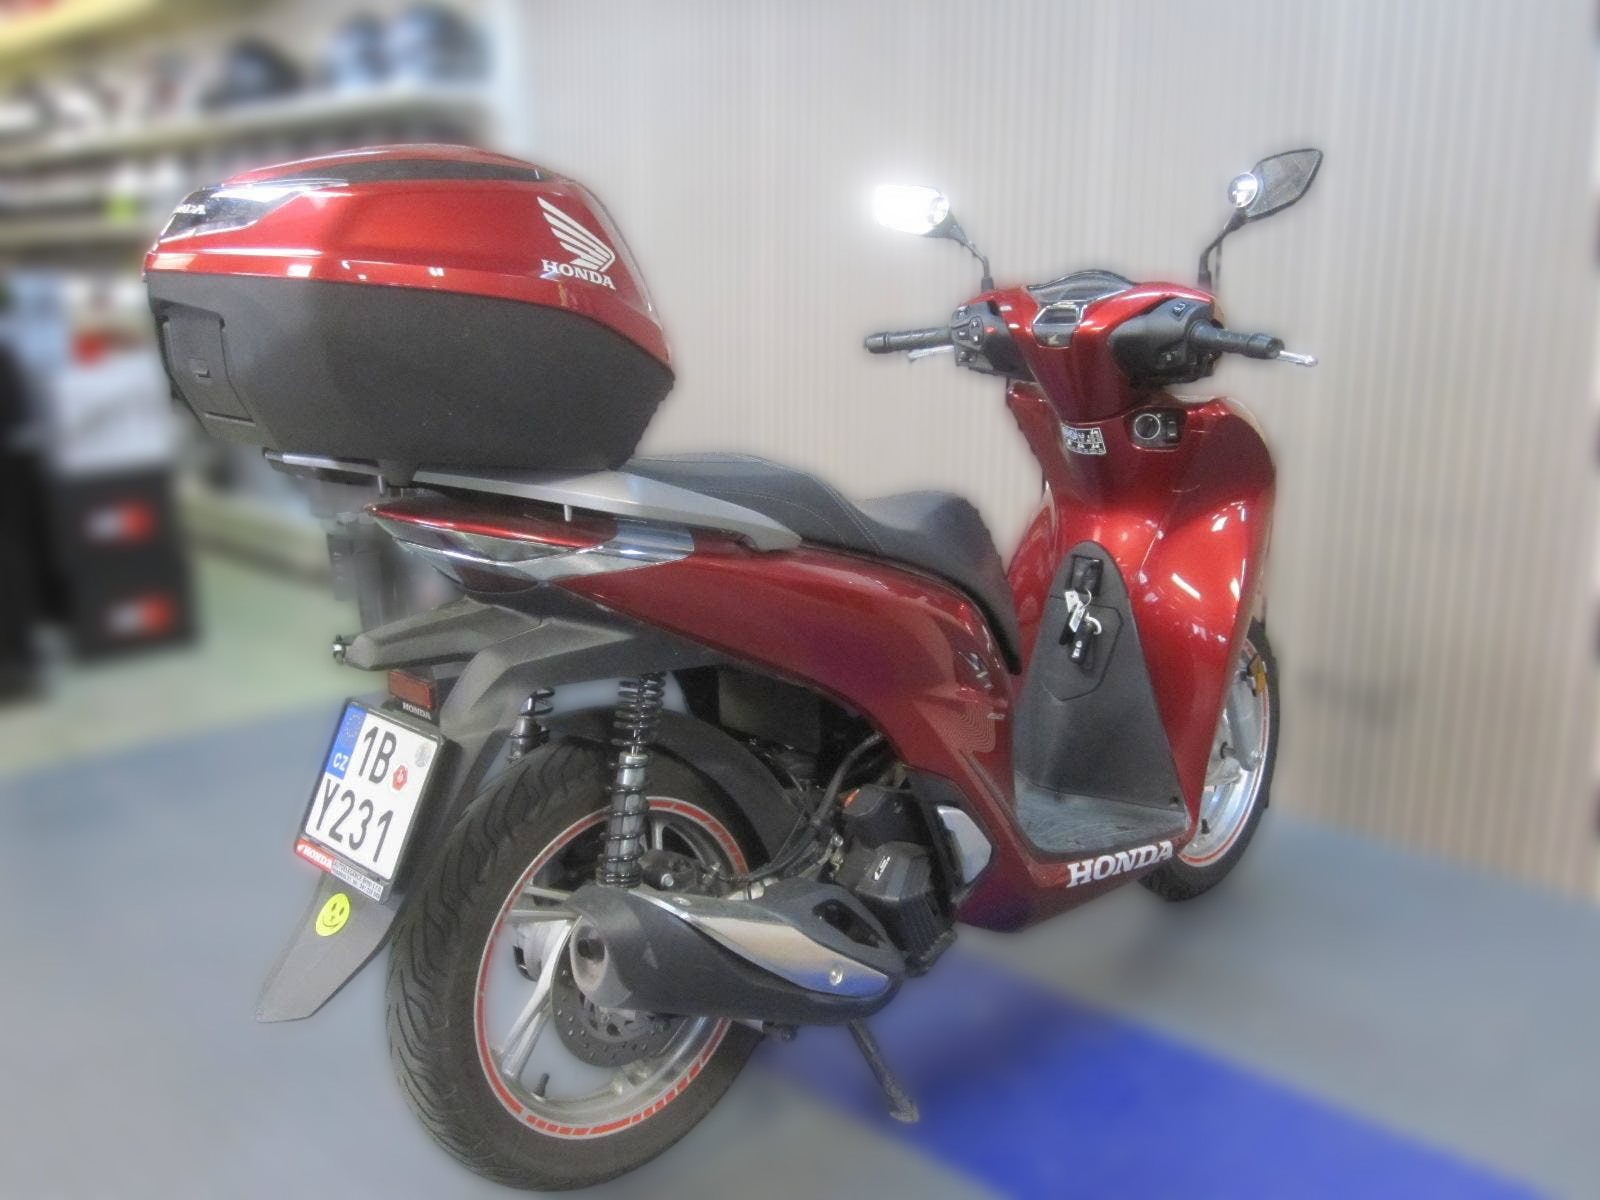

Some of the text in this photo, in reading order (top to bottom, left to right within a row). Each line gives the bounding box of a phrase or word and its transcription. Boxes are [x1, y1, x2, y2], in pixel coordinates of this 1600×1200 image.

[541, 259, 617, 291] HONDA
[402, 702, 432, 720] HONDA
[333, 753, 348, 771] CZ
[358, 726, 397, 784] 1B
[316, 778, 393, 863] Y231
[1066, 840, 1174, 889] HONDA
